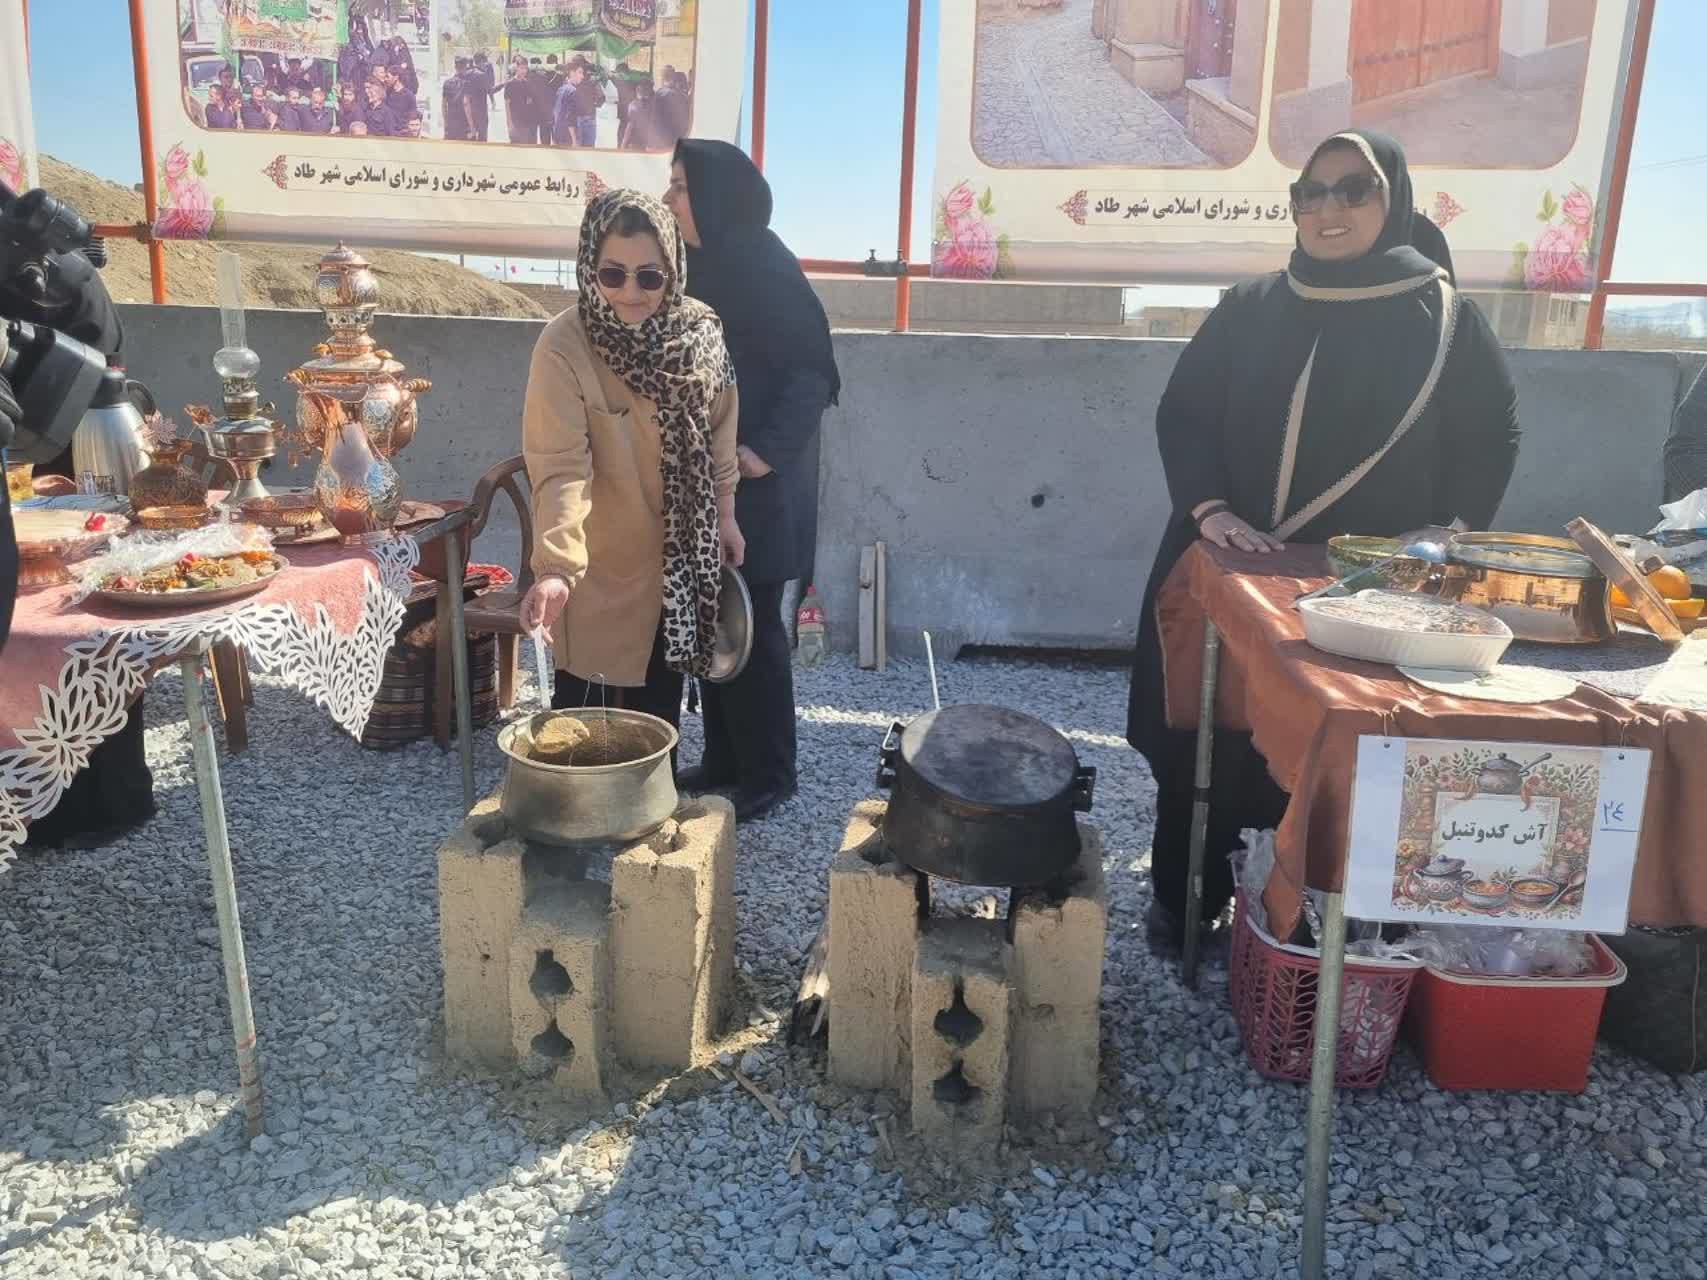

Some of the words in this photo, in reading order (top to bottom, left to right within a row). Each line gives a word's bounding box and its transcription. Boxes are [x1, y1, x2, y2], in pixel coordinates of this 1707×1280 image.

[294, 162, 316, 179] طاد
[319, 163, 341, 185] شهر
[344, 164, 386, 186] اسلامی
[389, 167, 429, 190] شورای
[431, 175, 440, 191] و
[442, 171, 497, 193] شهرداری
[499, 179, 541, 195] عمومی
[545, 175, 580, 198] روابط
[1095, 196, 1121, 214] طاد
[1122, 197, 1150, 219] شهر
[1152, 196, 1202, 220] اسلامی
[1204, 198, 1250, 220] شورای
[1252, 204, 1262, 221] و
[1512, 823, 1548, 845] آش
